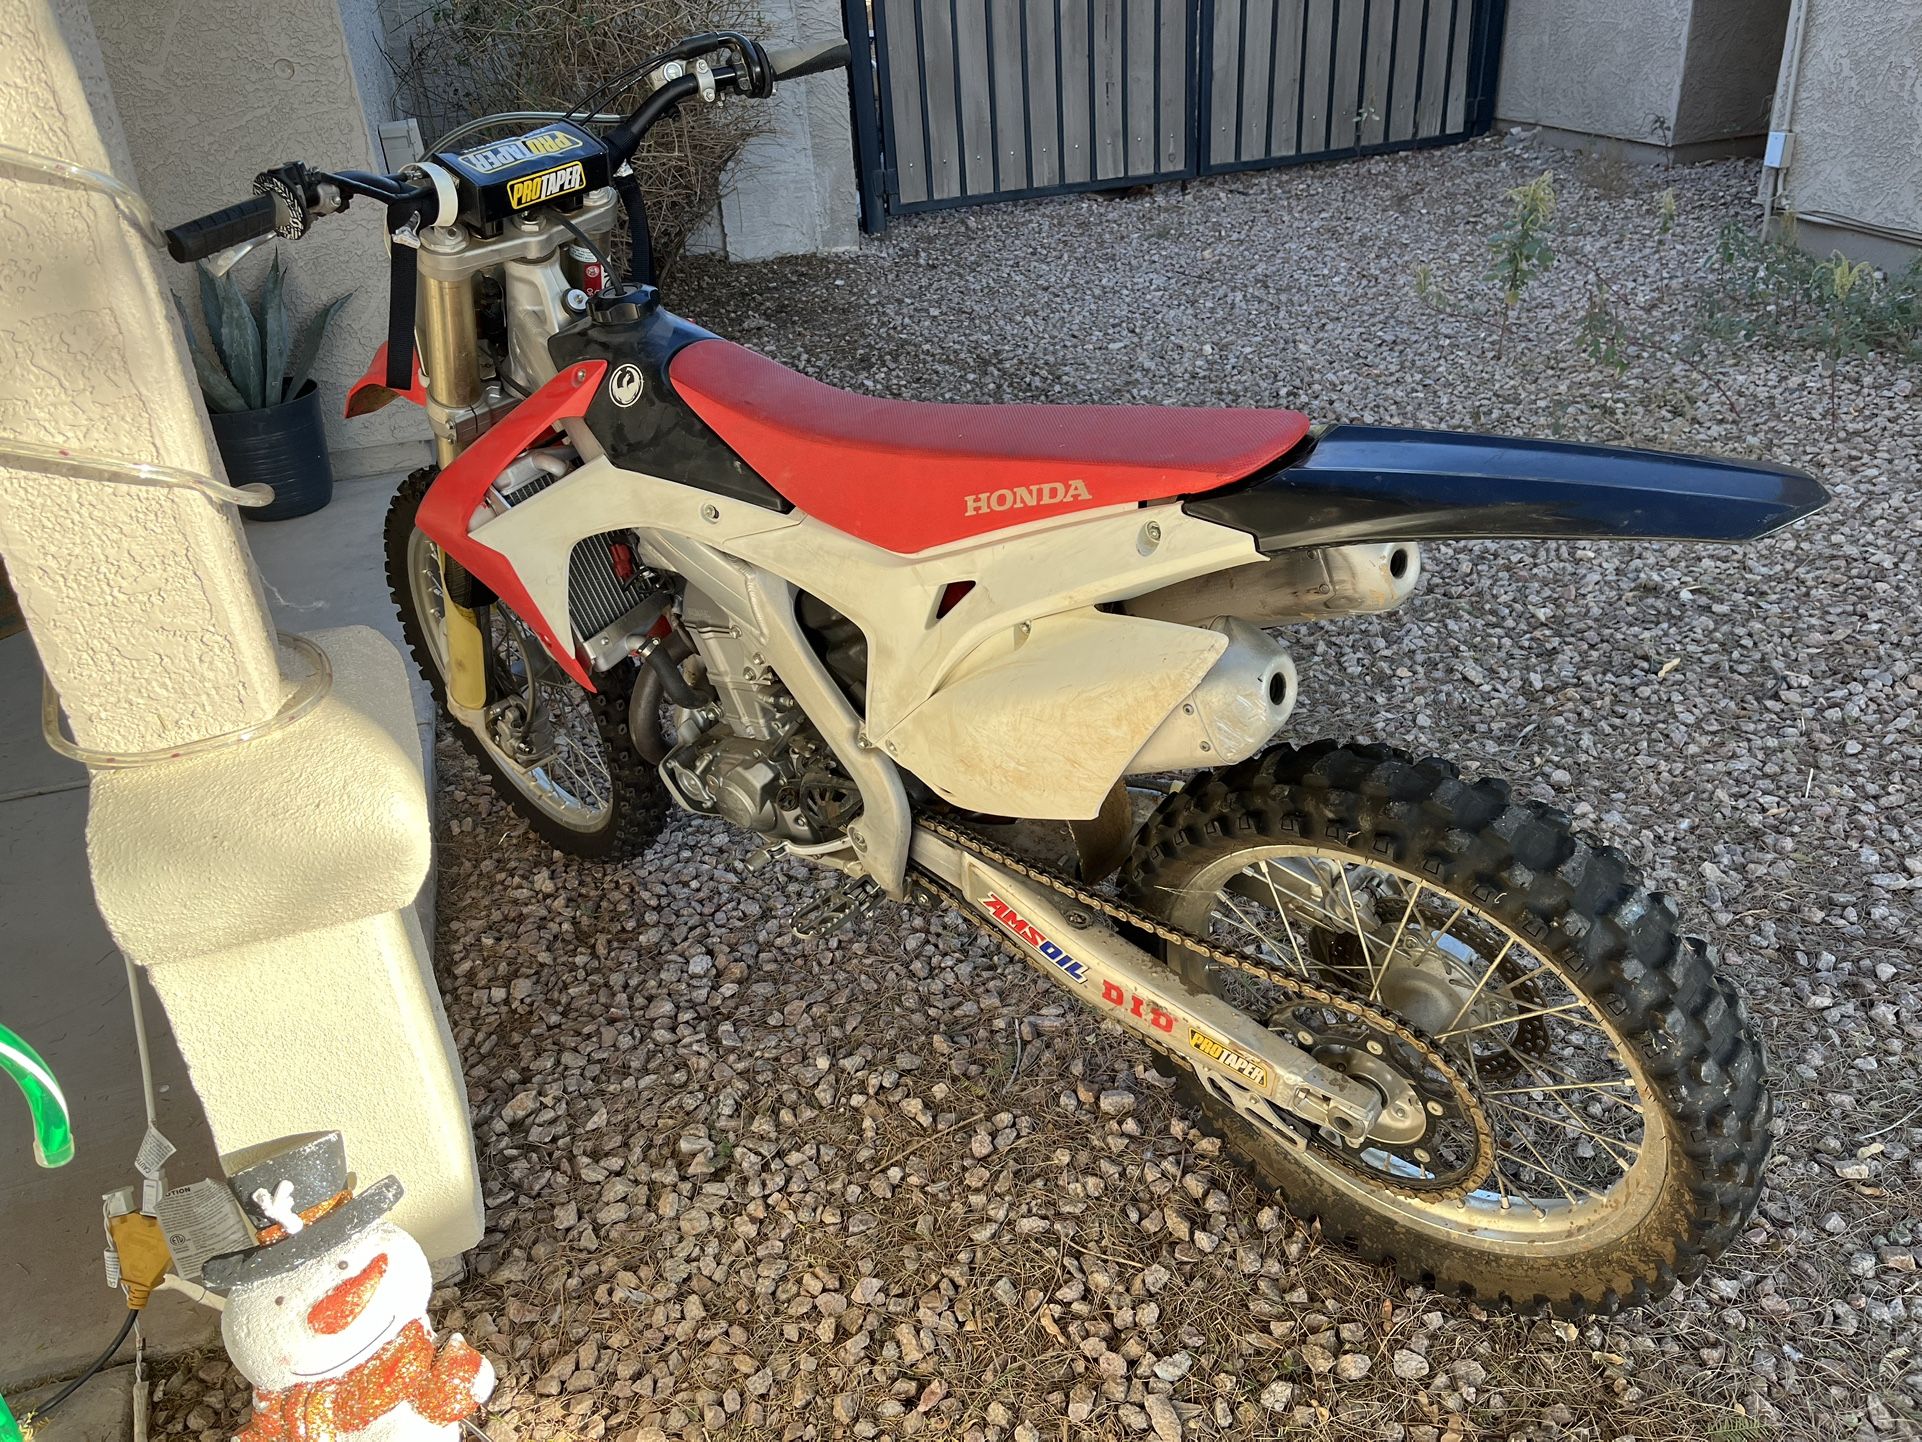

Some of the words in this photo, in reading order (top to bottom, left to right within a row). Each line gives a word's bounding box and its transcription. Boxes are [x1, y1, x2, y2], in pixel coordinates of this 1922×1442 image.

[512, 165, 582, 208] PROTAPER
[964, 479, 1093, 517] HONDA
[982, 893, 1084, 981] AMSOIL
[1191, 1031, 1265, 1085] PROTAPER
